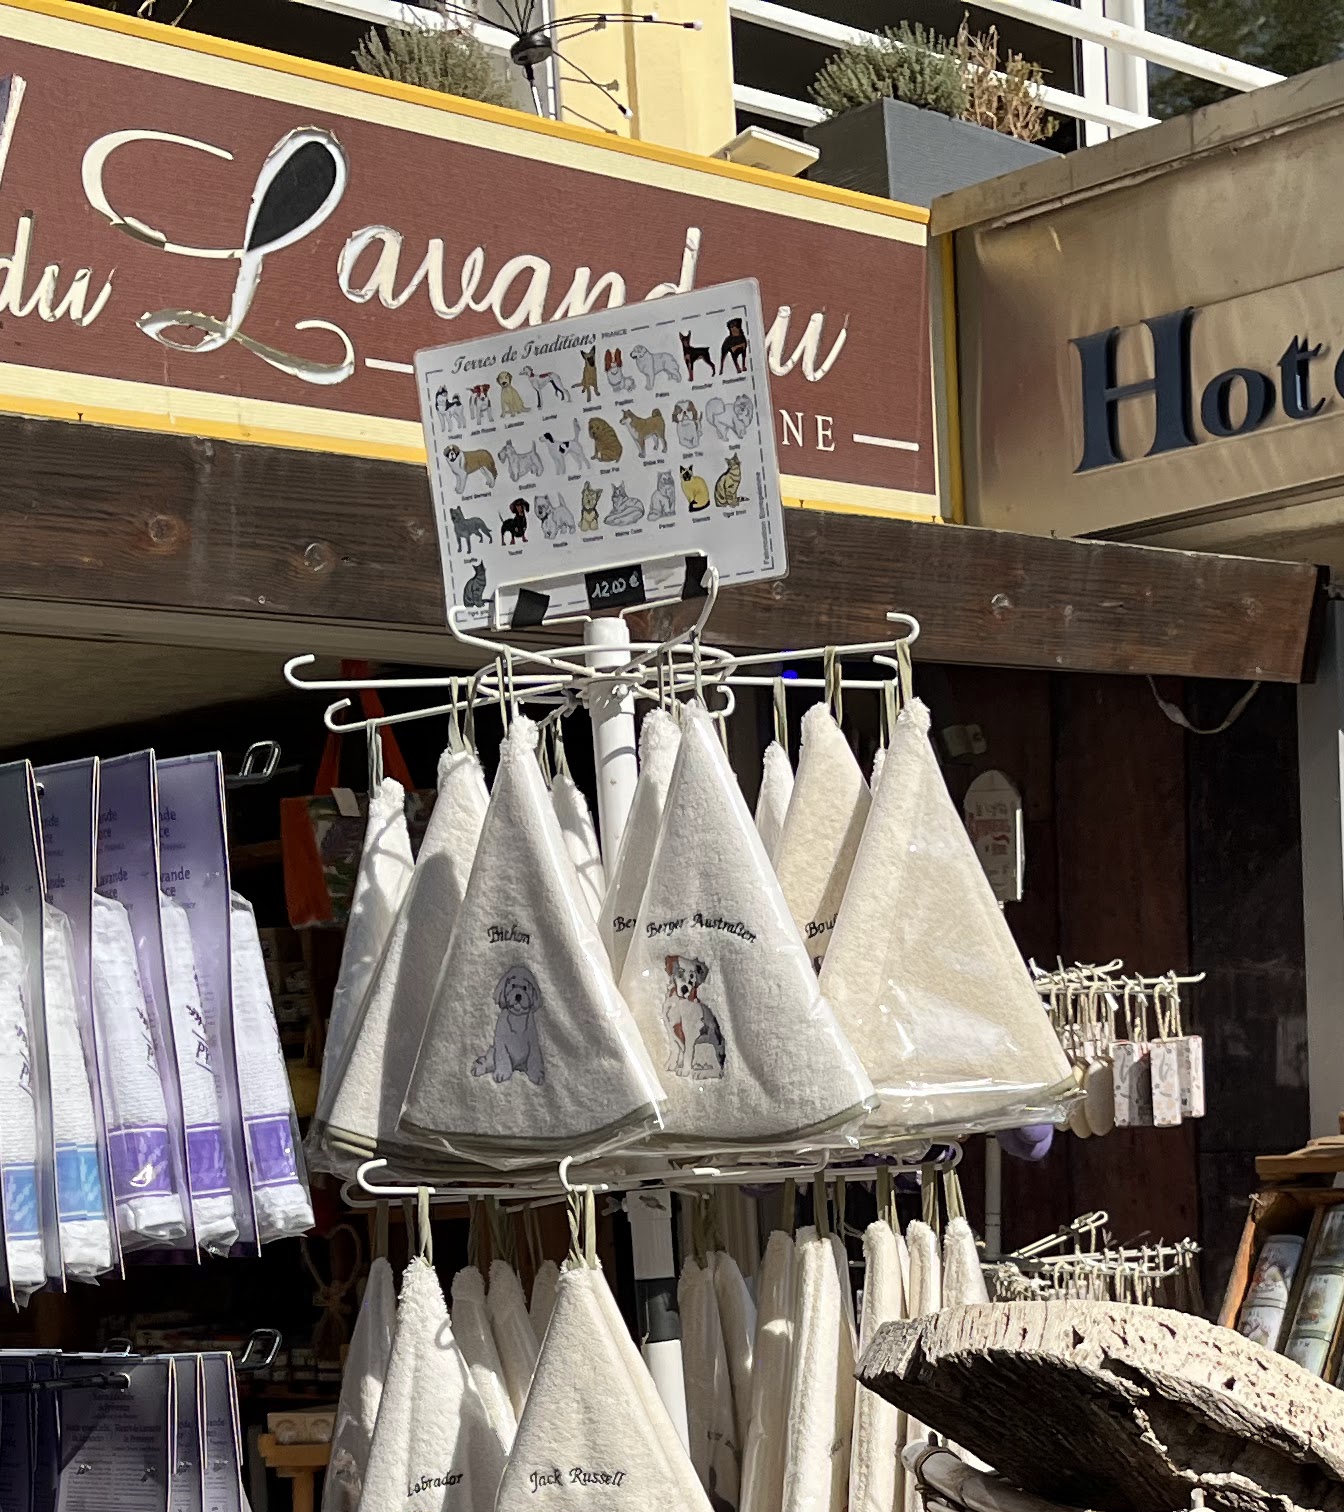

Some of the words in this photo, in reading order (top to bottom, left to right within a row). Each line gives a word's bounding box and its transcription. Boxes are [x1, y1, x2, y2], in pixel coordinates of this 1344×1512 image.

[81, 125, 850, 385] Lavandu
[451, 354, 497, 374] Terres
[501, 346, 518, 364] de
[521, 333, 596, 360] Traditions
[486, 924, 532, 947] Bichon
[646, 918, 687, 939] Berger
[406, 1471, 465, 1498] Labrador
[530, 1468, 563, 1494] Jack
[568, 1466, 627, 1488] Russell
